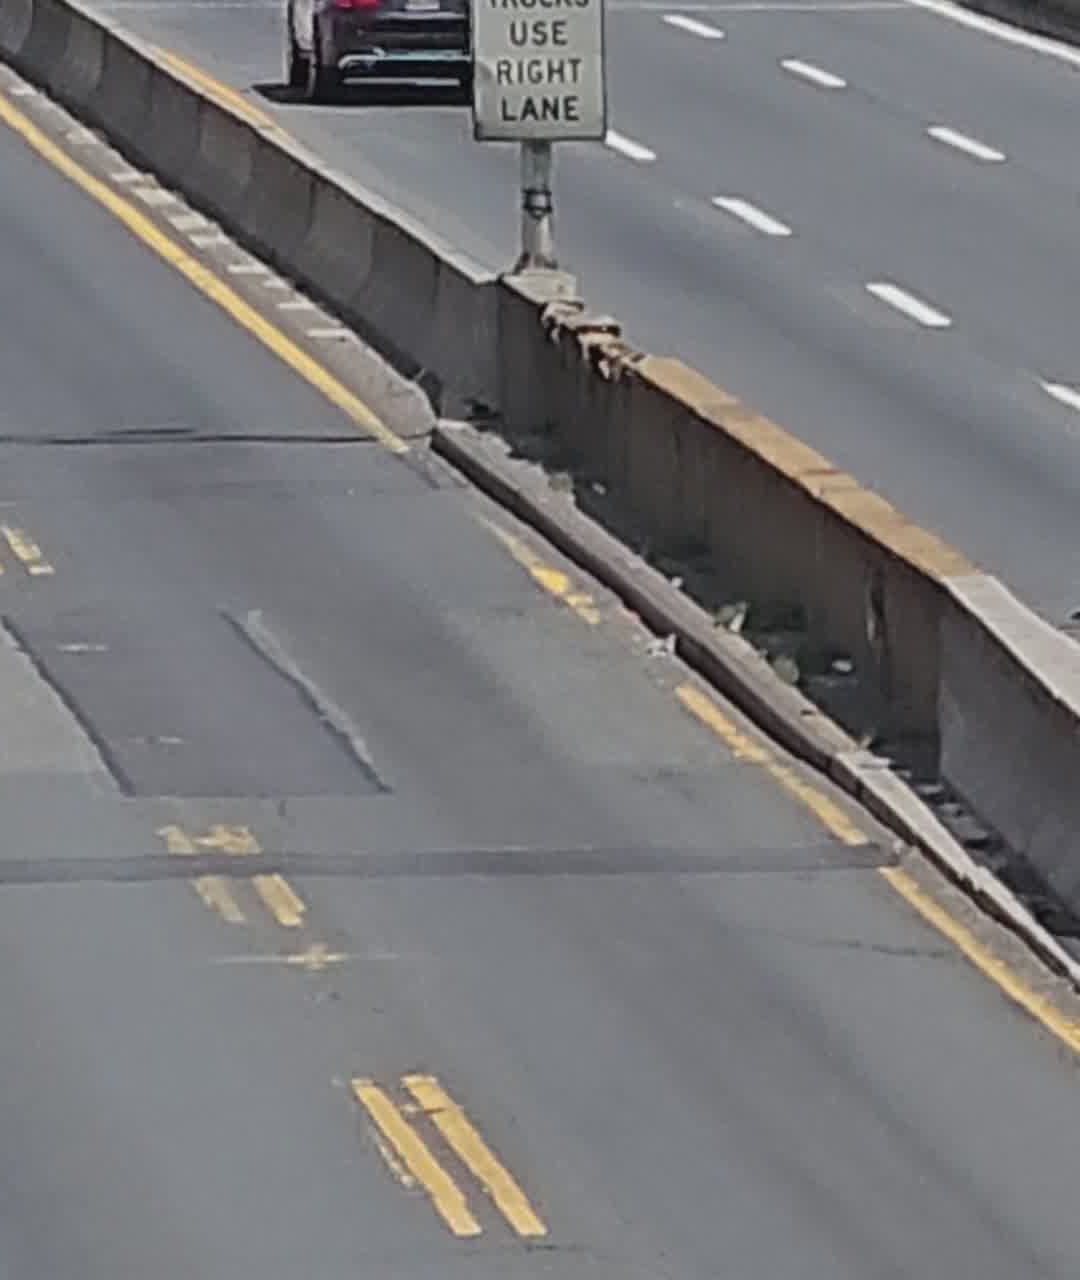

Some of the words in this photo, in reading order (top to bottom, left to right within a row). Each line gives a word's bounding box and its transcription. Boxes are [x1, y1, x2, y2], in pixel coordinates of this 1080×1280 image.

[509, 20, 568, 46] USE
[496, 58, 582, 85] RIGHT
[501, 96, 580, 121] LANE
